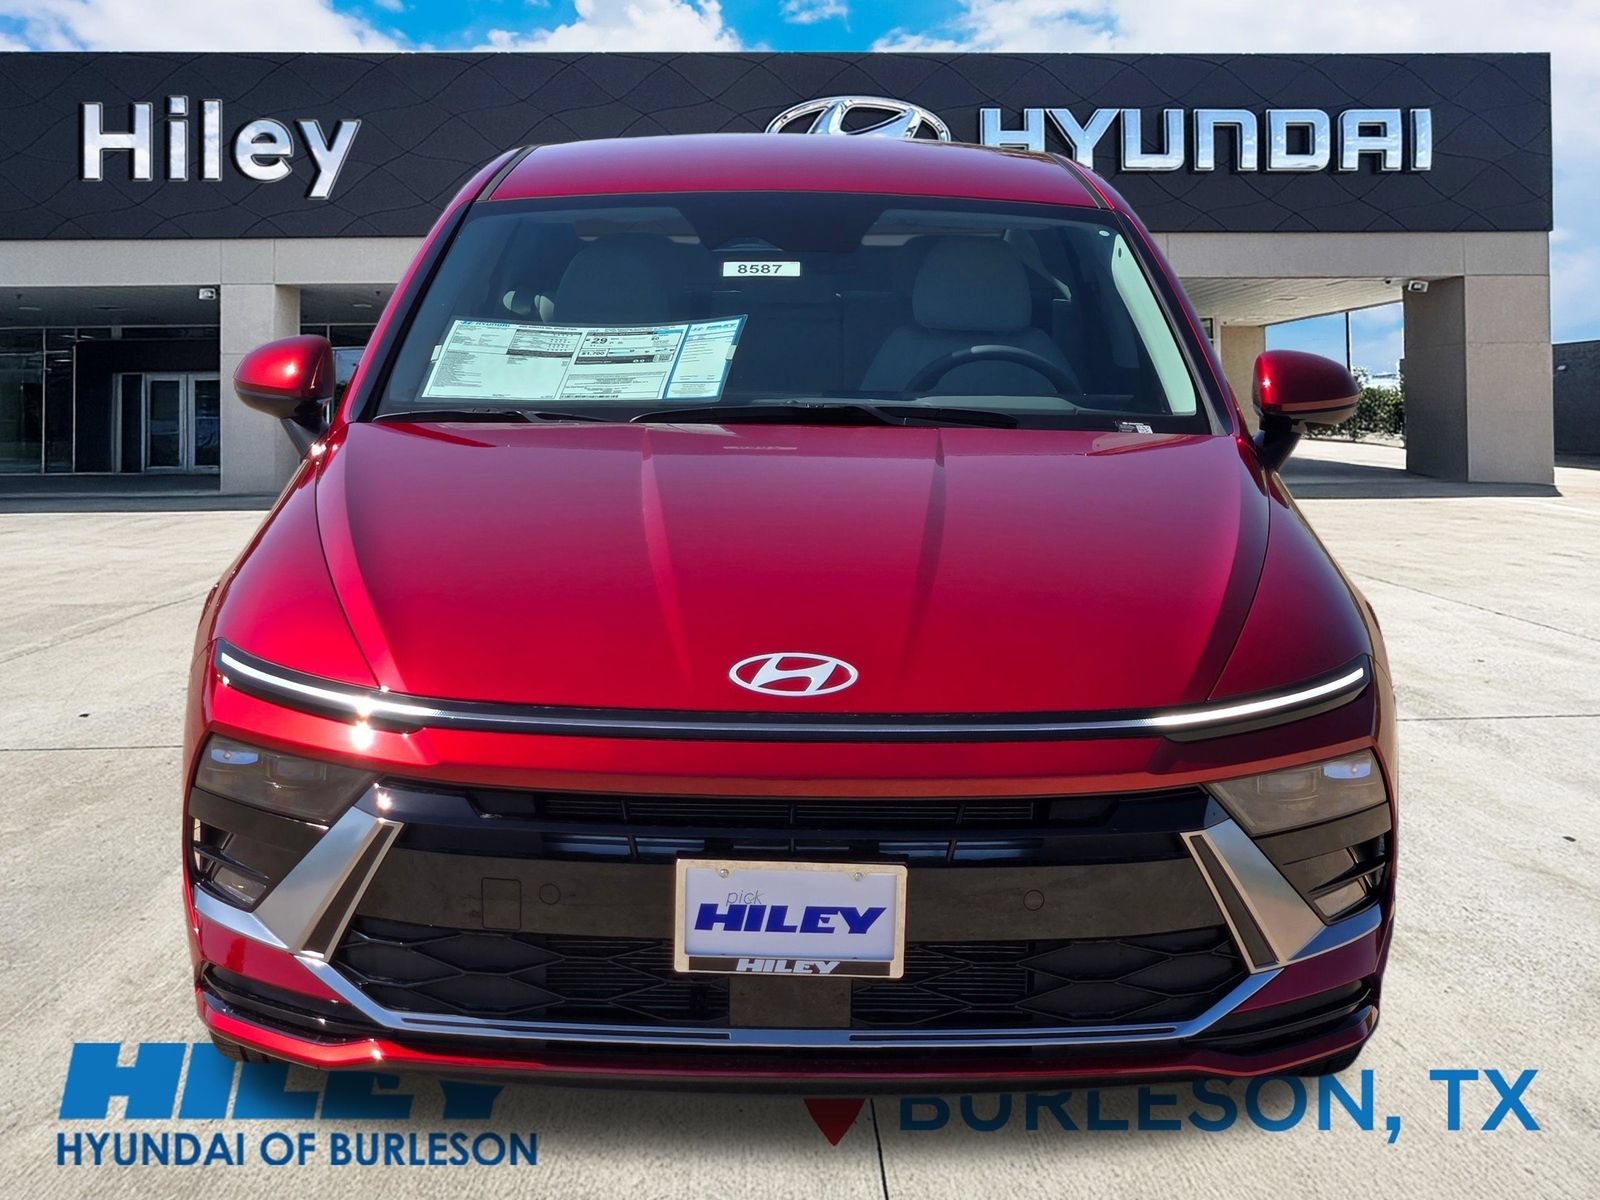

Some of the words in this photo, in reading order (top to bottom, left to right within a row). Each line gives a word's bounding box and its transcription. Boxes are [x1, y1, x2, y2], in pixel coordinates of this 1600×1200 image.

[79, 94, 362, 199] Hiley
[979, 107, 1433, 172] HYUNDAI
[737, 264, 783, 274] 8587
[591, 337, 608, 345] 29
[726, 889, 767, 906] pick
[694, 903, 887, 934] HILEY
[736, 959, 841, 974] HILEY
